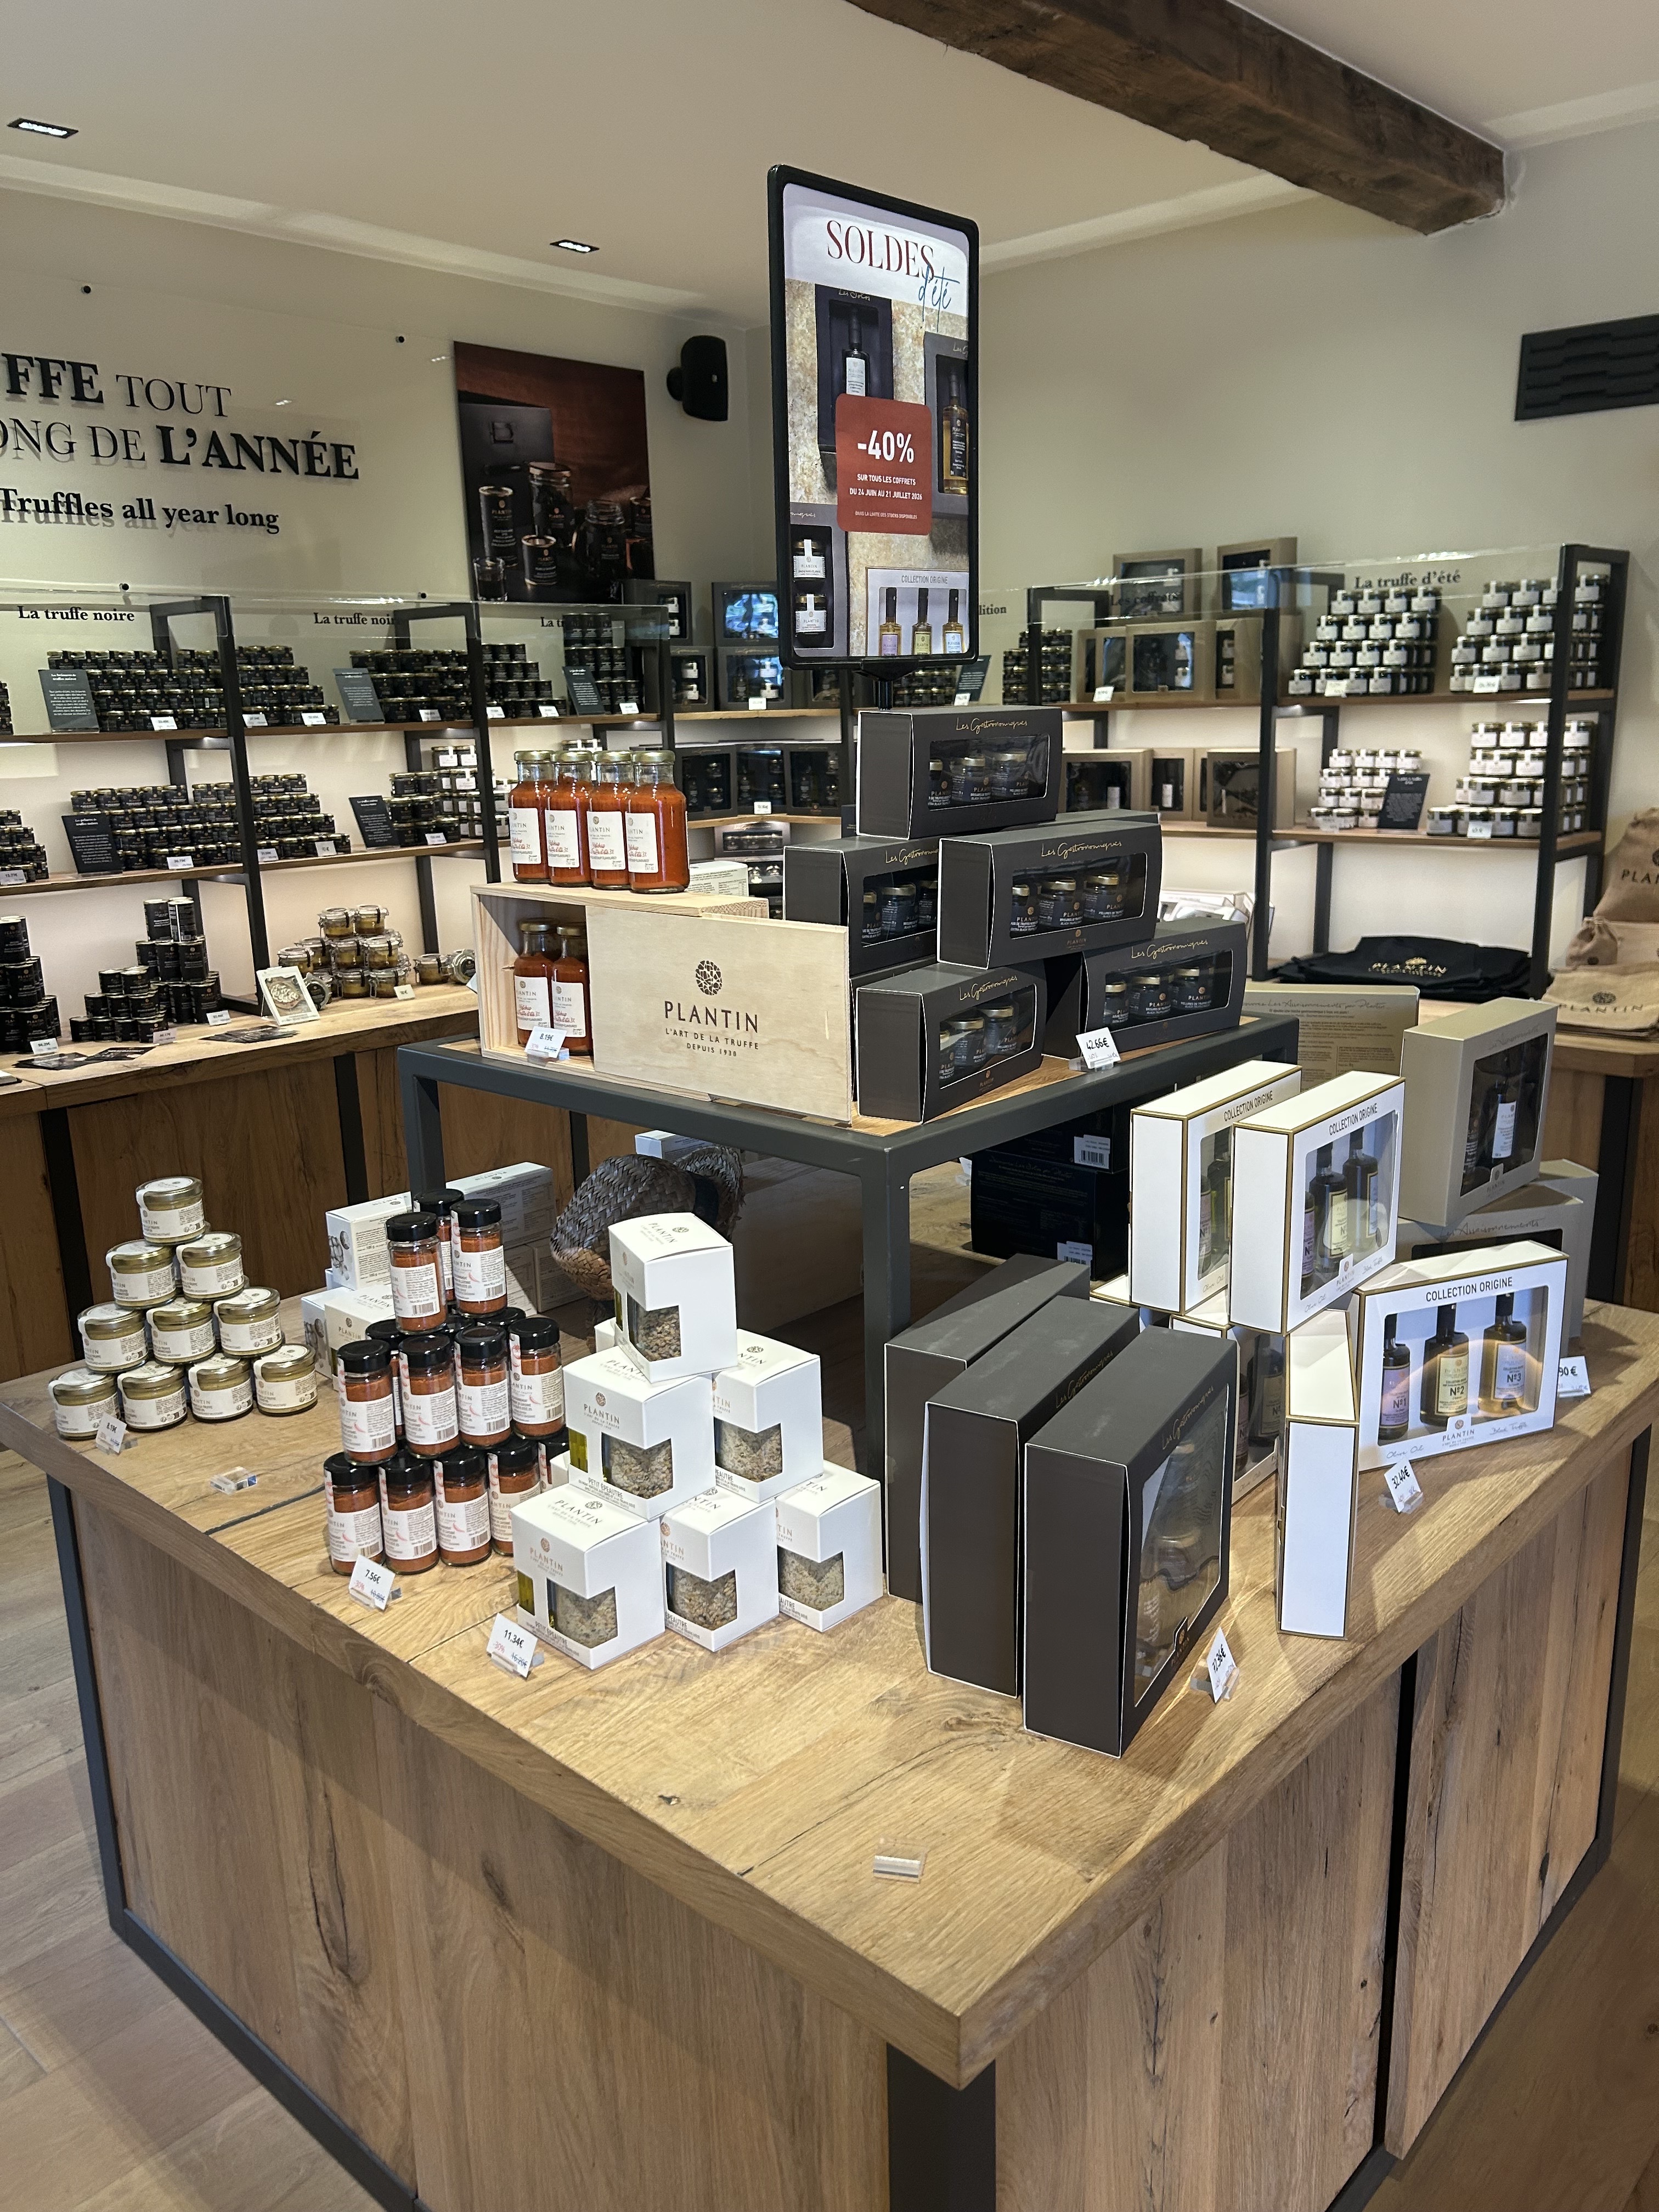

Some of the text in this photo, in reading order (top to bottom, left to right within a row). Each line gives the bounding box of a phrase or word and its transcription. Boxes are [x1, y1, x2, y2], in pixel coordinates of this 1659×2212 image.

[827, 220, 934, 280] SOLDES
[115, 374, 232, 417] TOUT
[87, 426, 146, 461] DE
[156, 425, 359, 479] L'ANNÉE
[857, 430, 915, 464] -40%
[857, 473, 868, 482] SUR
[868, 475, 882, 483] TOUS
[893, 477, 916, 486] COFFRETS
[892, 492, 911, 500] JUILLET
[0, 488, 280, 534] Truffles all year long
[930, 576, 948, 584] ORIGINE
[1355, 569, 1461, 589] La truffe d'été
[17, 606, 135, 621] La truffe noire
[313, 612, 394, 625] La truffe noir
[540, 617, 553, 628] La
[956, 717, 1028, 734] Les Gastronomiques
[885, 850, 898, 864] Les
[1042, 842, 1122, 859] Les Gastronomiques
[1131, 940, 1208, 960] Les Gastronomiques
[959, 974, 1018, 1001] Les Gastronomiques
[664, 1000, 758, 1034] PLANTIN
[665, 1028, 689, 1038] L'ART
[694, 1032, 704, 1041] DE
[725, 1038, 759, 1050] TRUFFE
[687, 1042, 737, 1057] DEPUIS 1930
[1224, 1092, 1273, 1121] COLLECTION ORIGINE
[1329, 1103, 1378, 1136] COLLECTION ORIGINE
[648, 1222, 678, 1243] PLANTIN
[1336, 1269, 1355, 1287] PLANTIN
[1426, 1277, 1513, 1302] COLLECTION ORIGINE
[338, 1327, 362, 1339] PLANTIN
[584, 1403, 620, 1424] PLANTIN
[1163, 1434, 1172, 1450] Les
[1442, 1429, 1475, 1442] PLANTIN
[588, 1477, 623, 1499] PETIT ÉPEAUTRE
[555, 1500, 602, 1523] PLANTIN
[530, 1547, 563, 1571] PLANTIN
[365, 1569, 381, 1584] 7.56€
[504, 1629, 524, 1648] 11.34€
